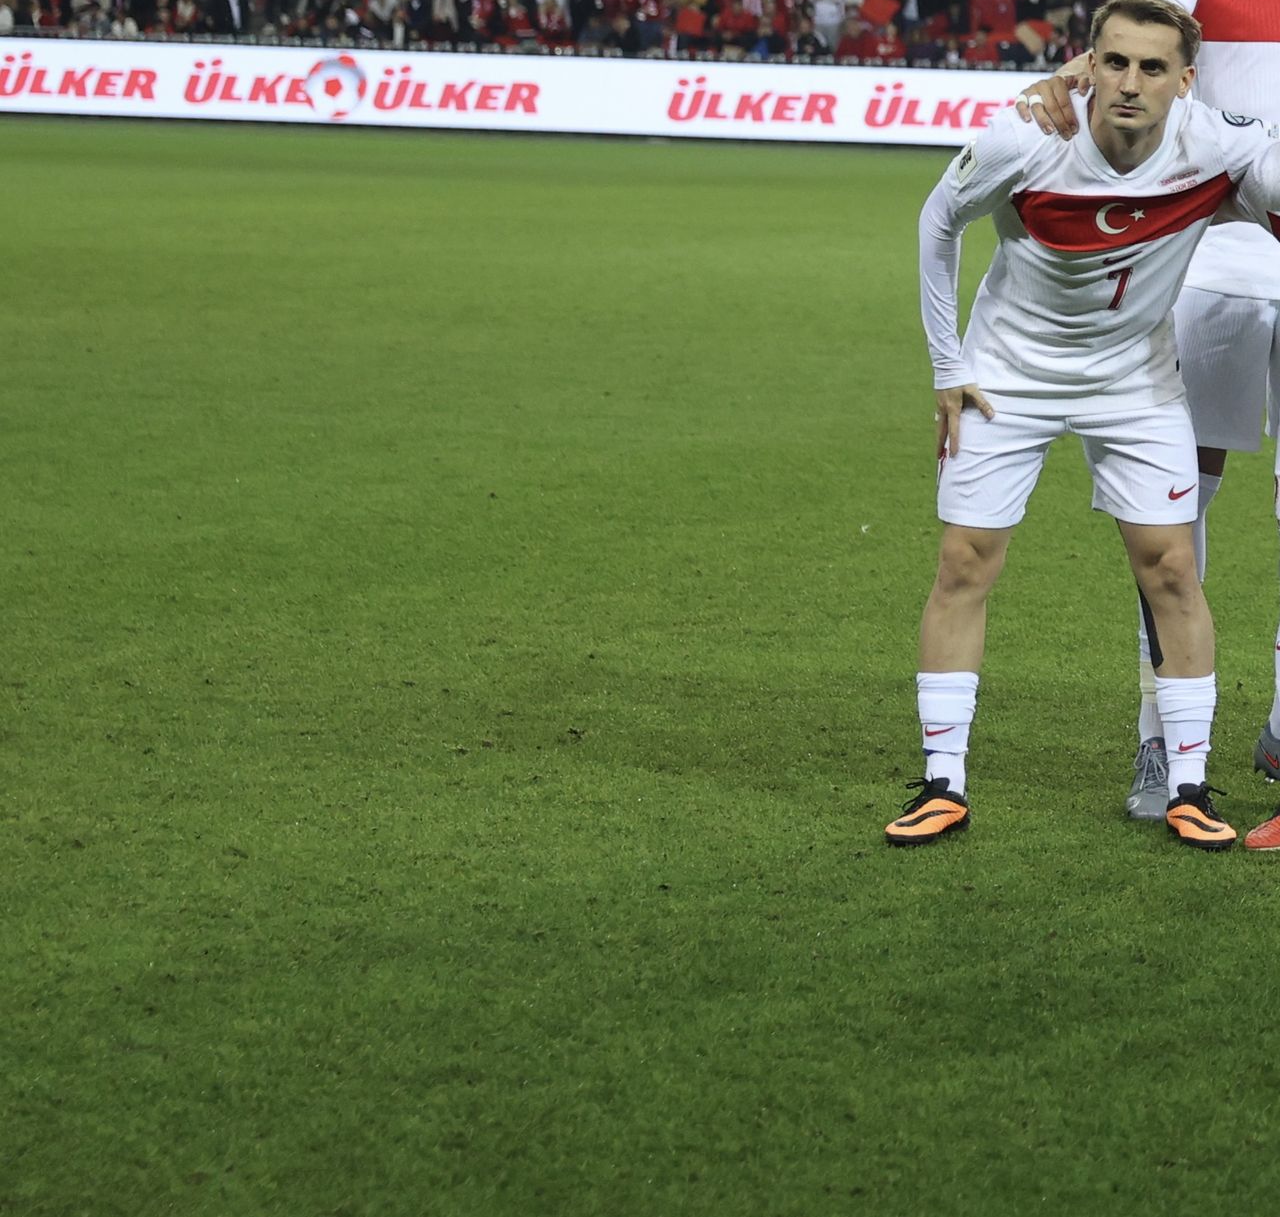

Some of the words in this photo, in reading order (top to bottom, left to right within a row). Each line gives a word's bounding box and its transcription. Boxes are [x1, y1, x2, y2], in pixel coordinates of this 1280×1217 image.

[0, 52, 158, 99] ÜLKER
[184, 59, 312, 104] ÜLKE
[373, 65, 541, 114] ÜLKER
[667, 77, 837, 125] ÜLKER
[864, 83, 1015, 129] ÜLKE
[1108, 267, 1133, 311] 7
